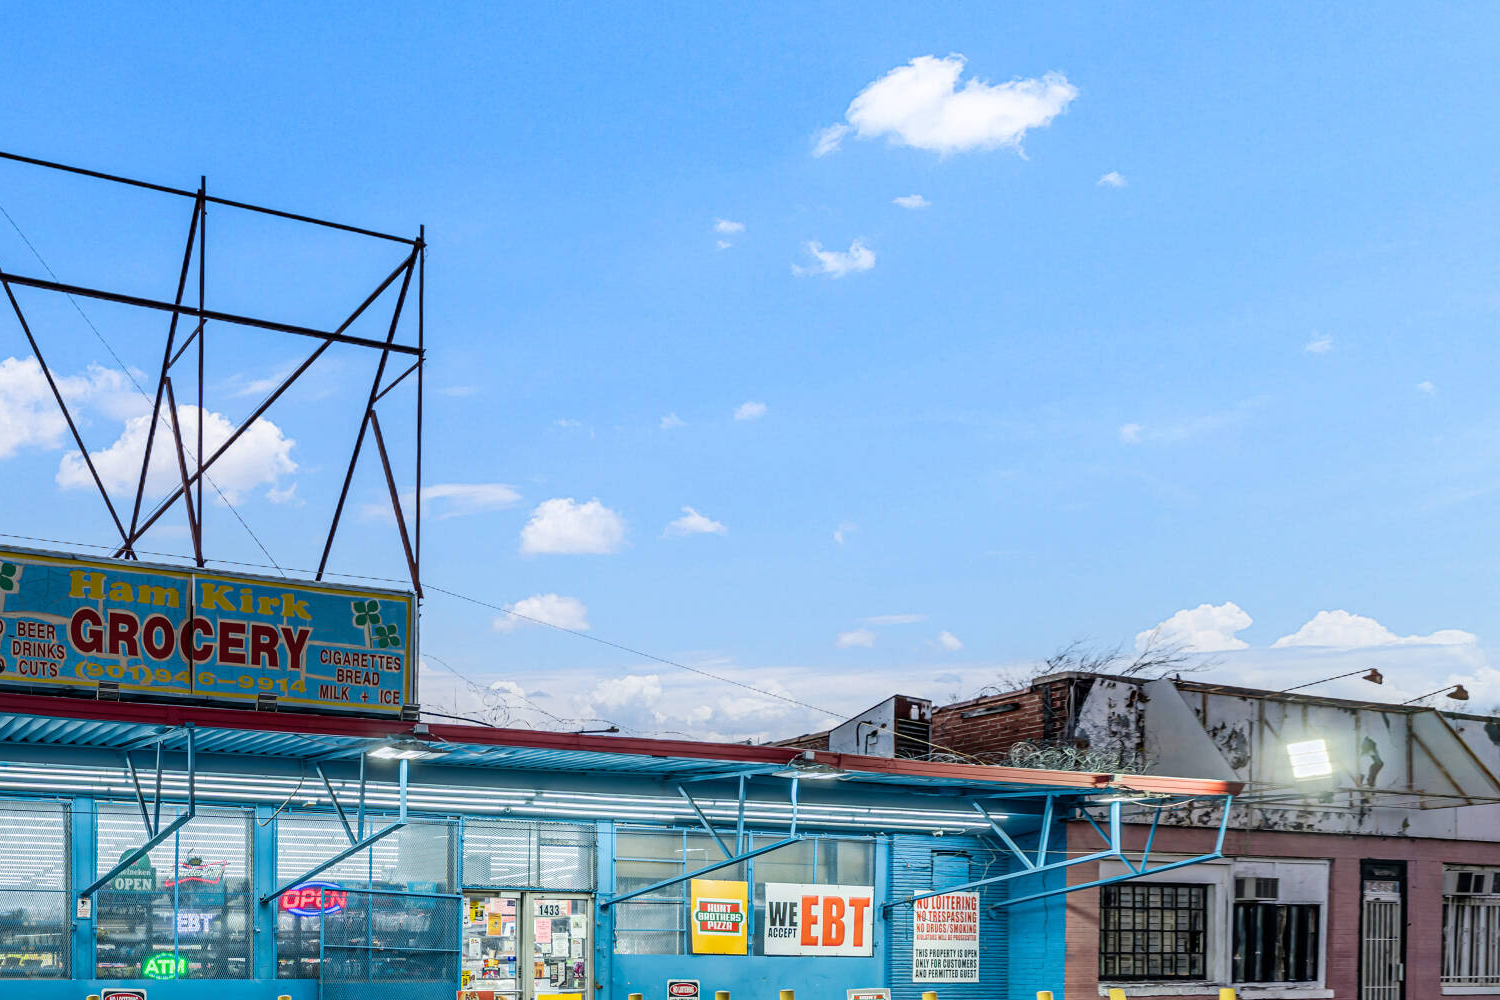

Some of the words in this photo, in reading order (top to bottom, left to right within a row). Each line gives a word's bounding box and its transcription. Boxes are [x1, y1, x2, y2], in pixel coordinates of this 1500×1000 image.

[69, 570, 180, 608] Ham
[201, 583, 312, 620] Kirk
[17, 622, 55, 639] BEER
[70, 608, 310, 669] GROCERY
[12, 640, 66, 660] DRINKS
[320, 649, 401, 671] CIGARETTES
[19, 660, 58, 677] CUTS
[75, 661, 307, 693] (901)946-9914
[337, 669, 380, 686] BREAD
[319, 684, 350, 701] MILK
[380, 690, 400, 705] ICE
[114, 878, 152, 891] OPEN
[281, 888, 348, 910] OPEN
[916, 897, 929, 910] NO
[931, 895, 977, 911] LOITERING
[539, 904, 560, 916] 1433
[707, 903, 732, 914] HUNT
[768, 902, 798, 927] WE
[916, 910, 926, 922] NO
[928, 911, 976, 922] TRESPASSING
[176, 913, 213, 933] EBT
[698, 912, 742, 922] BROTHERS
[801, 895, 871, 947] EBT
[707, 921, 733, 931] PIZZA
[768, 928, 797, 938] ACCEPT
[916, 924, 924, 933] NO
[926, 924, 976, 933] DRUGS/SMOKING
[916, 948, 928, 958] THIS
[929, 949, 956, 958] PROPERTY
[958, 949, 963, 958] IS
[964, 949, 977, 958] OPEN
[144, 959, 186, 974] ATM
[916, 958, 929, 968] ONLY
[930, 959, 942, 968] FOR
[942, 959, 977, 968] CUSTOMERS
[916, 970, 927, 978] AND
[928, 970, 958, 978] PERMITTED
[960, 970, 977, 978] GUEST
